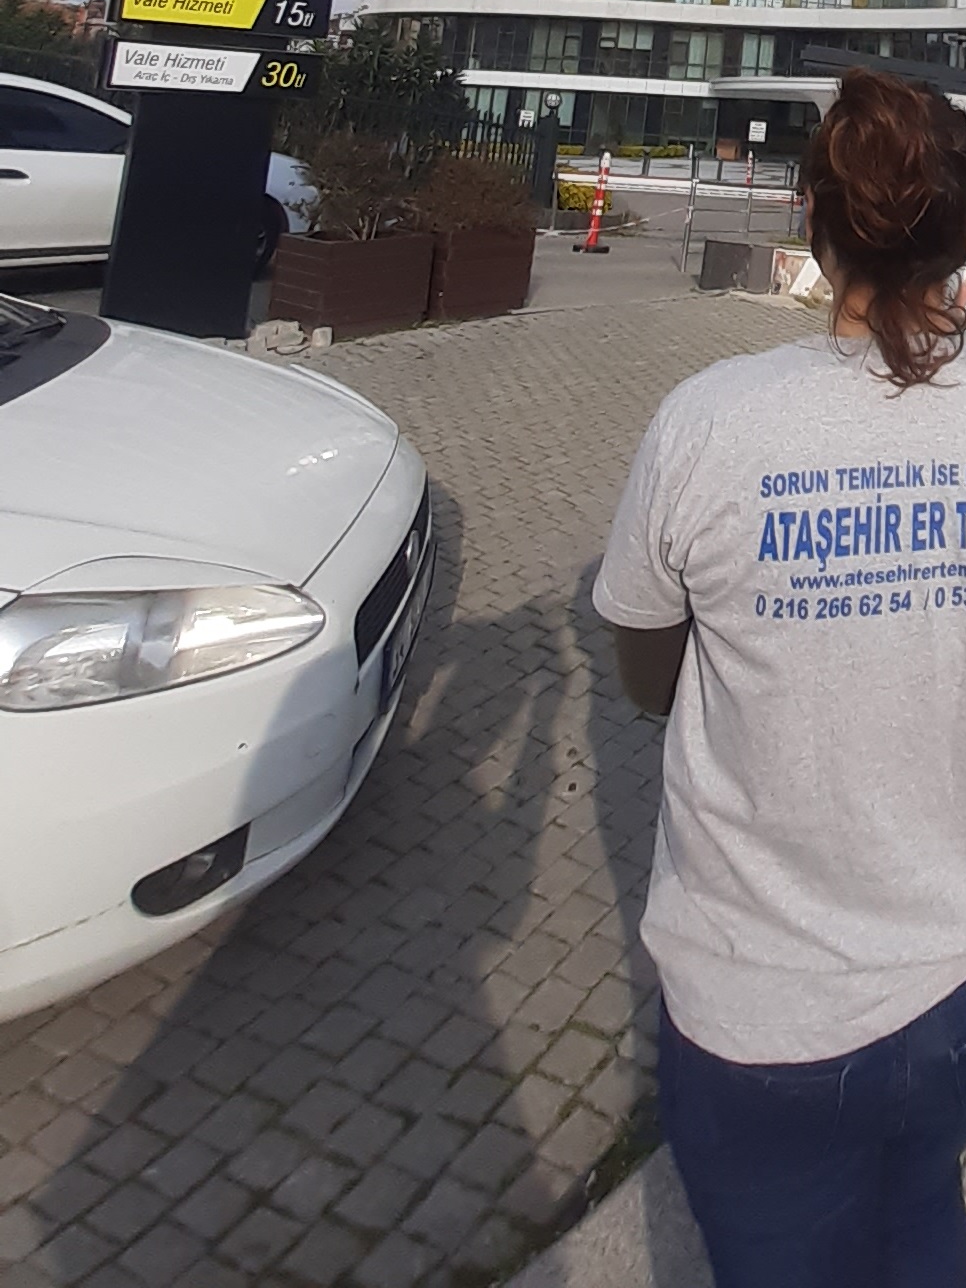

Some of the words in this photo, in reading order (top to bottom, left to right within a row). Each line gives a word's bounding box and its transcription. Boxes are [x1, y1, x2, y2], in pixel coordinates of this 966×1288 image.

[125, 49, 160, 67] Vale
[164, 52, 228, 72] Hizmeti
[760, 469, 829, 498] SORUN
[835, 460, 925, 492] TEMİZLİK
[931, 459, 960, 487] İSE
[758, 492, 903, 572] ATAŞEHİR
[911, 501, 946, 551] ER
[756, 594, 767, 615] 0
[772, 597, 809, 620] 216
[815, 595, 853, 619] 266
[859, 593, 883, 616] 62
[889, 590, 912, 612] 54
[935, 587, 946, 608] 0
